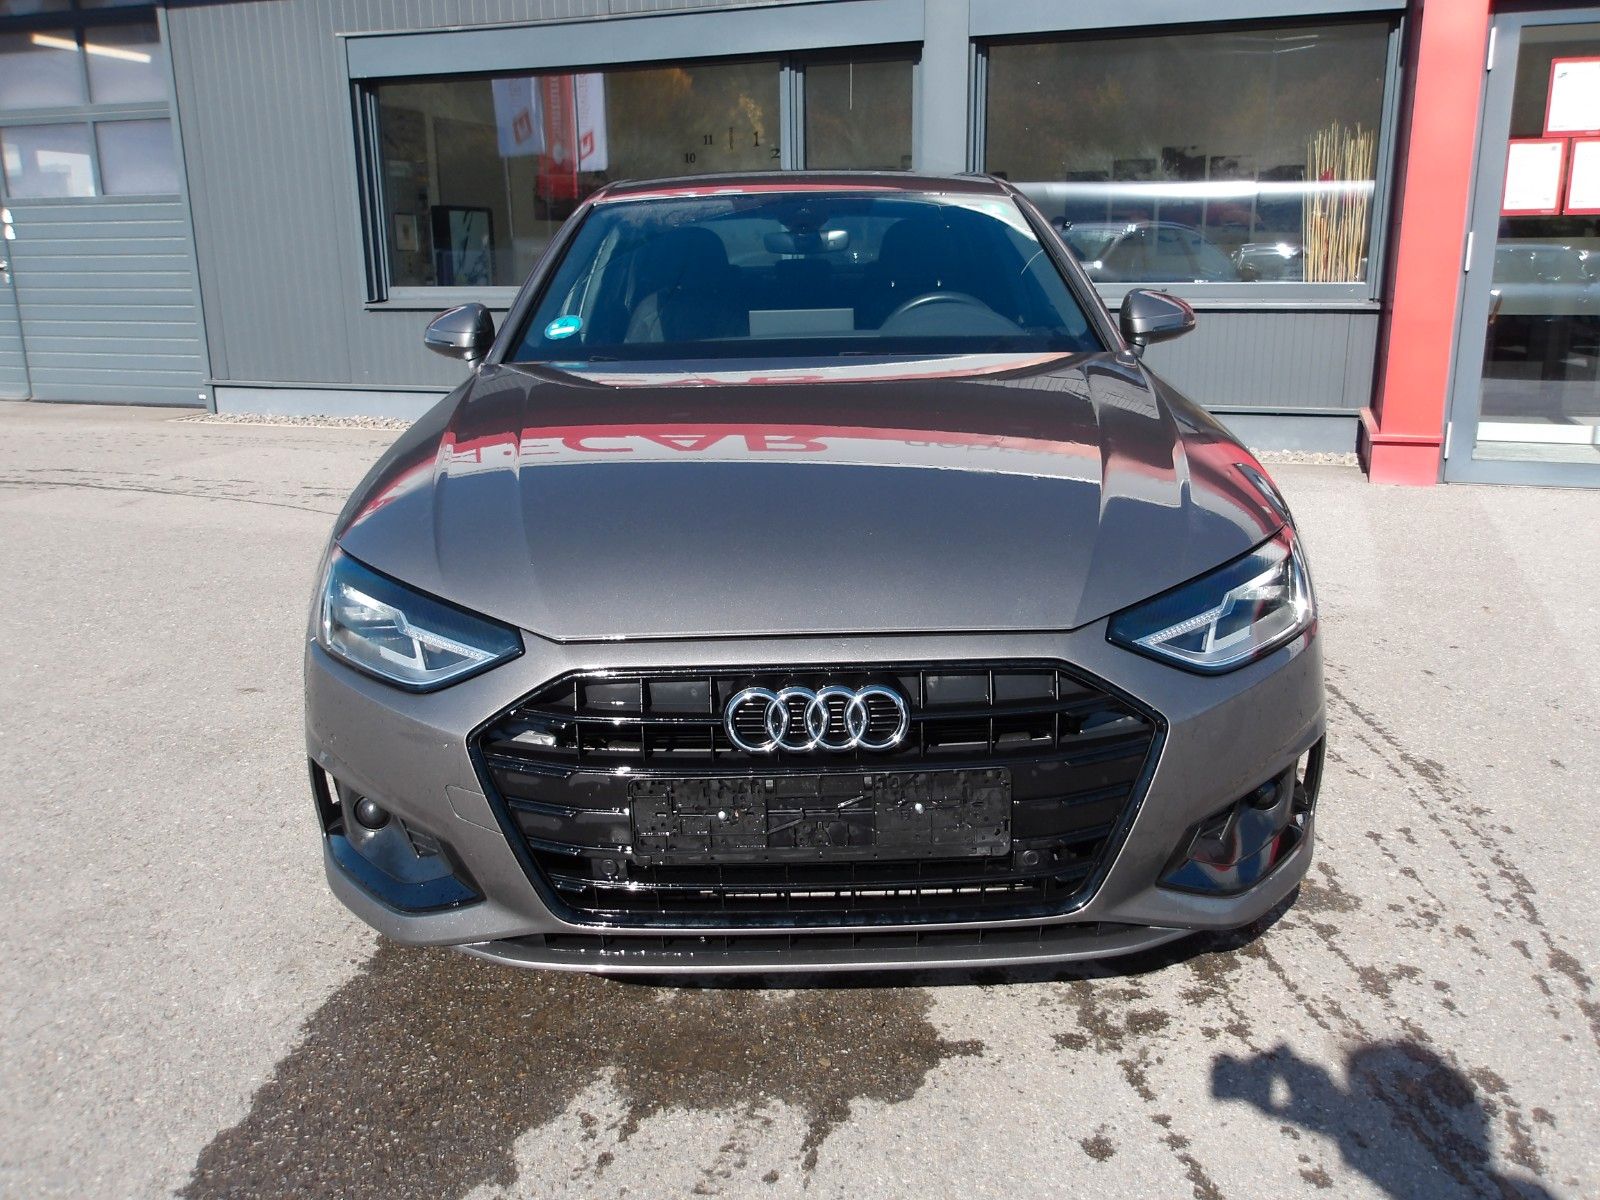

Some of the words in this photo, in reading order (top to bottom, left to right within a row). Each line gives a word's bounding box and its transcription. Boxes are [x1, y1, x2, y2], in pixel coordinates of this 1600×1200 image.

[703, 134, 713, 145] 11
[753, 131, 760, 147] 1
[684, 152, 696, 164] 10
[770, 148, 781, 159] 2
